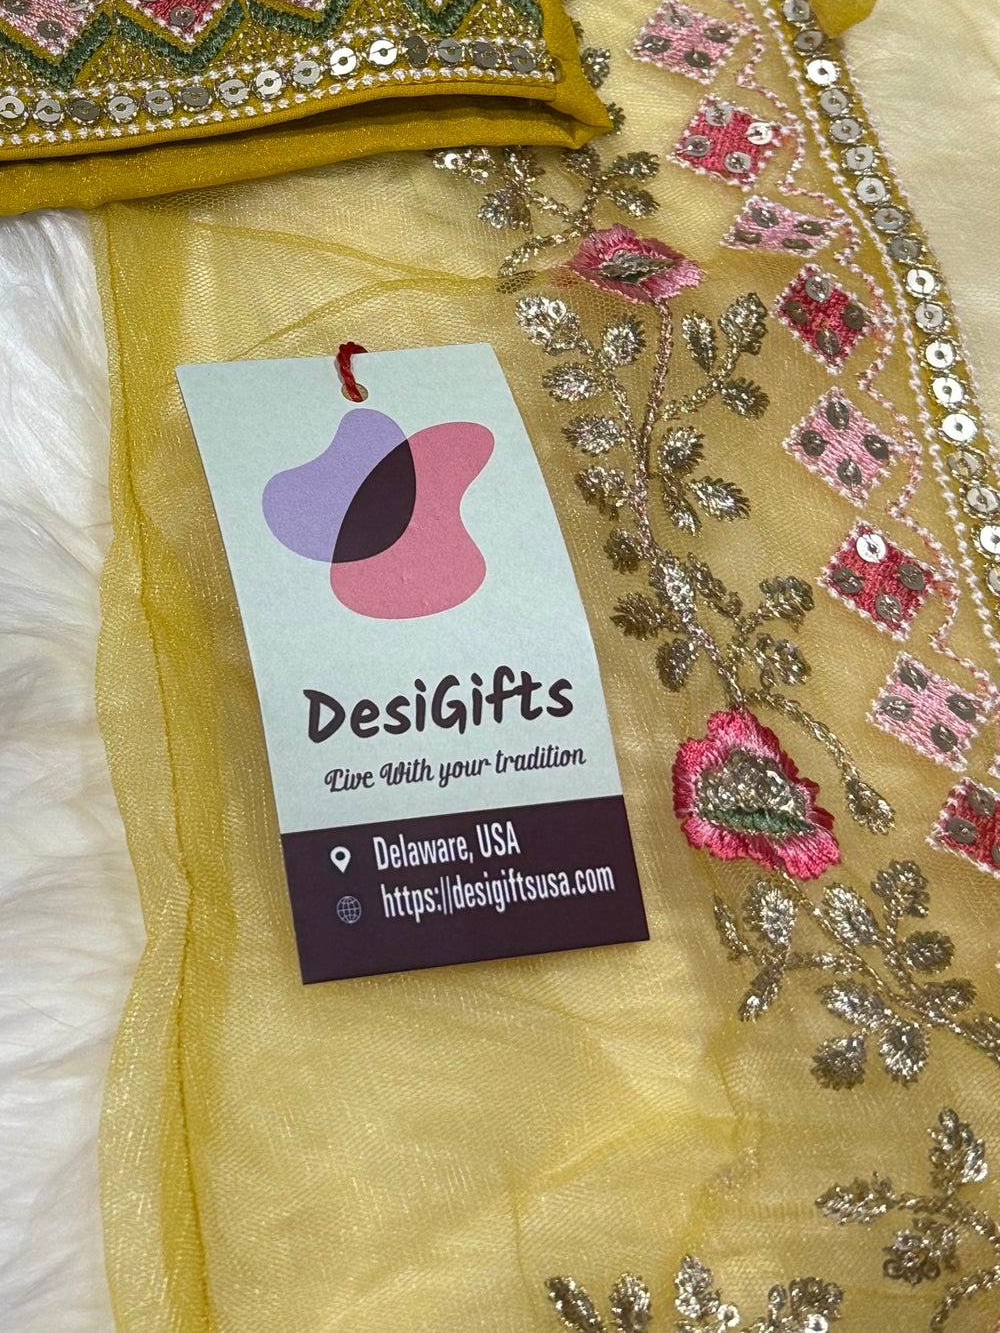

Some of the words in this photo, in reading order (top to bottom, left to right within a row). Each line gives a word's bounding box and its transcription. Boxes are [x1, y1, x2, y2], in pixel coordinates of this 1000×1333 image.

[302, 665, 574, 744] DesiGifts
[324, 768, 375, 793] Live
[379, 757, 434, 786] With
[438, 756, 491, 788] your
[495, 744, 587, 774] tradition
[373, 833, 474, 871] Delaware,
[476, 820, 521, 858] USA
[380, 865, 616, 923] https://desigiftsusa.com
